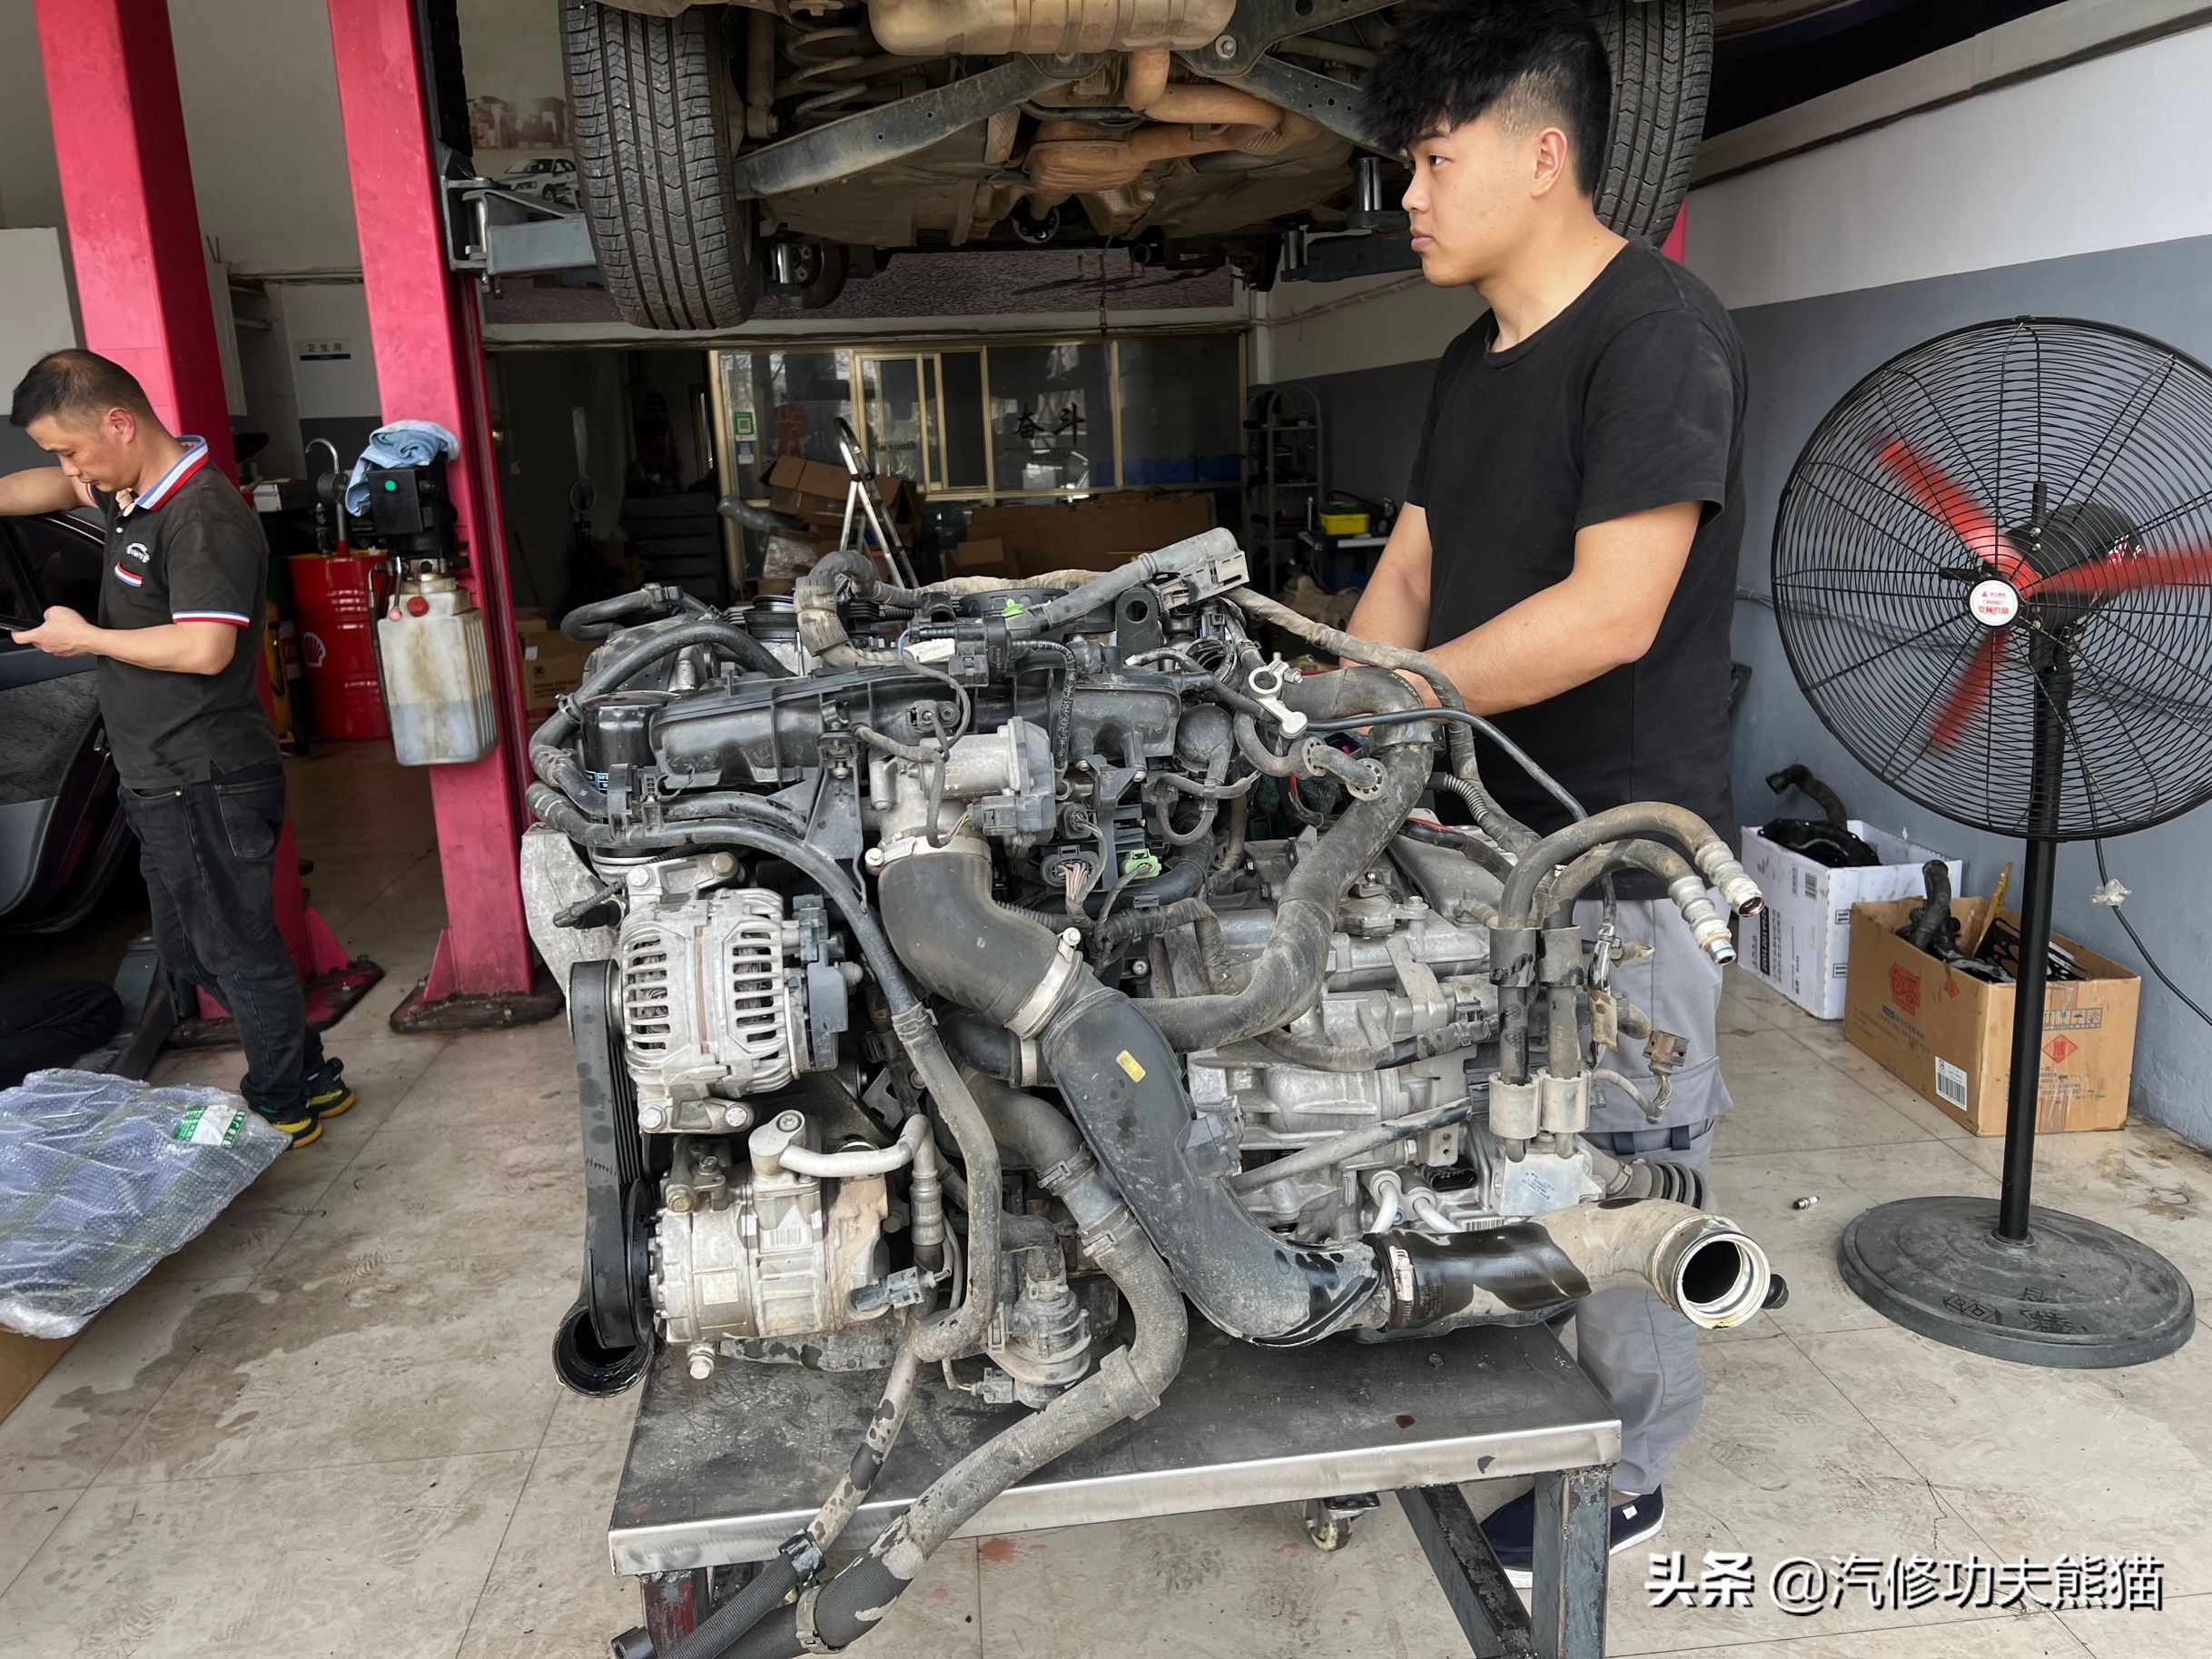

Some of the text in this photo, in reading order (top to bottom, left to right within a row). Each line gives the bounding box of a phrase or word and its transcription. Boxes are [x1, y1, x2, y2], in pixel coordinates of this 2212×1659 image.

[306, 342, 343, 352] 卫生间
[1012, 402, 1086, 447] 奋斗
